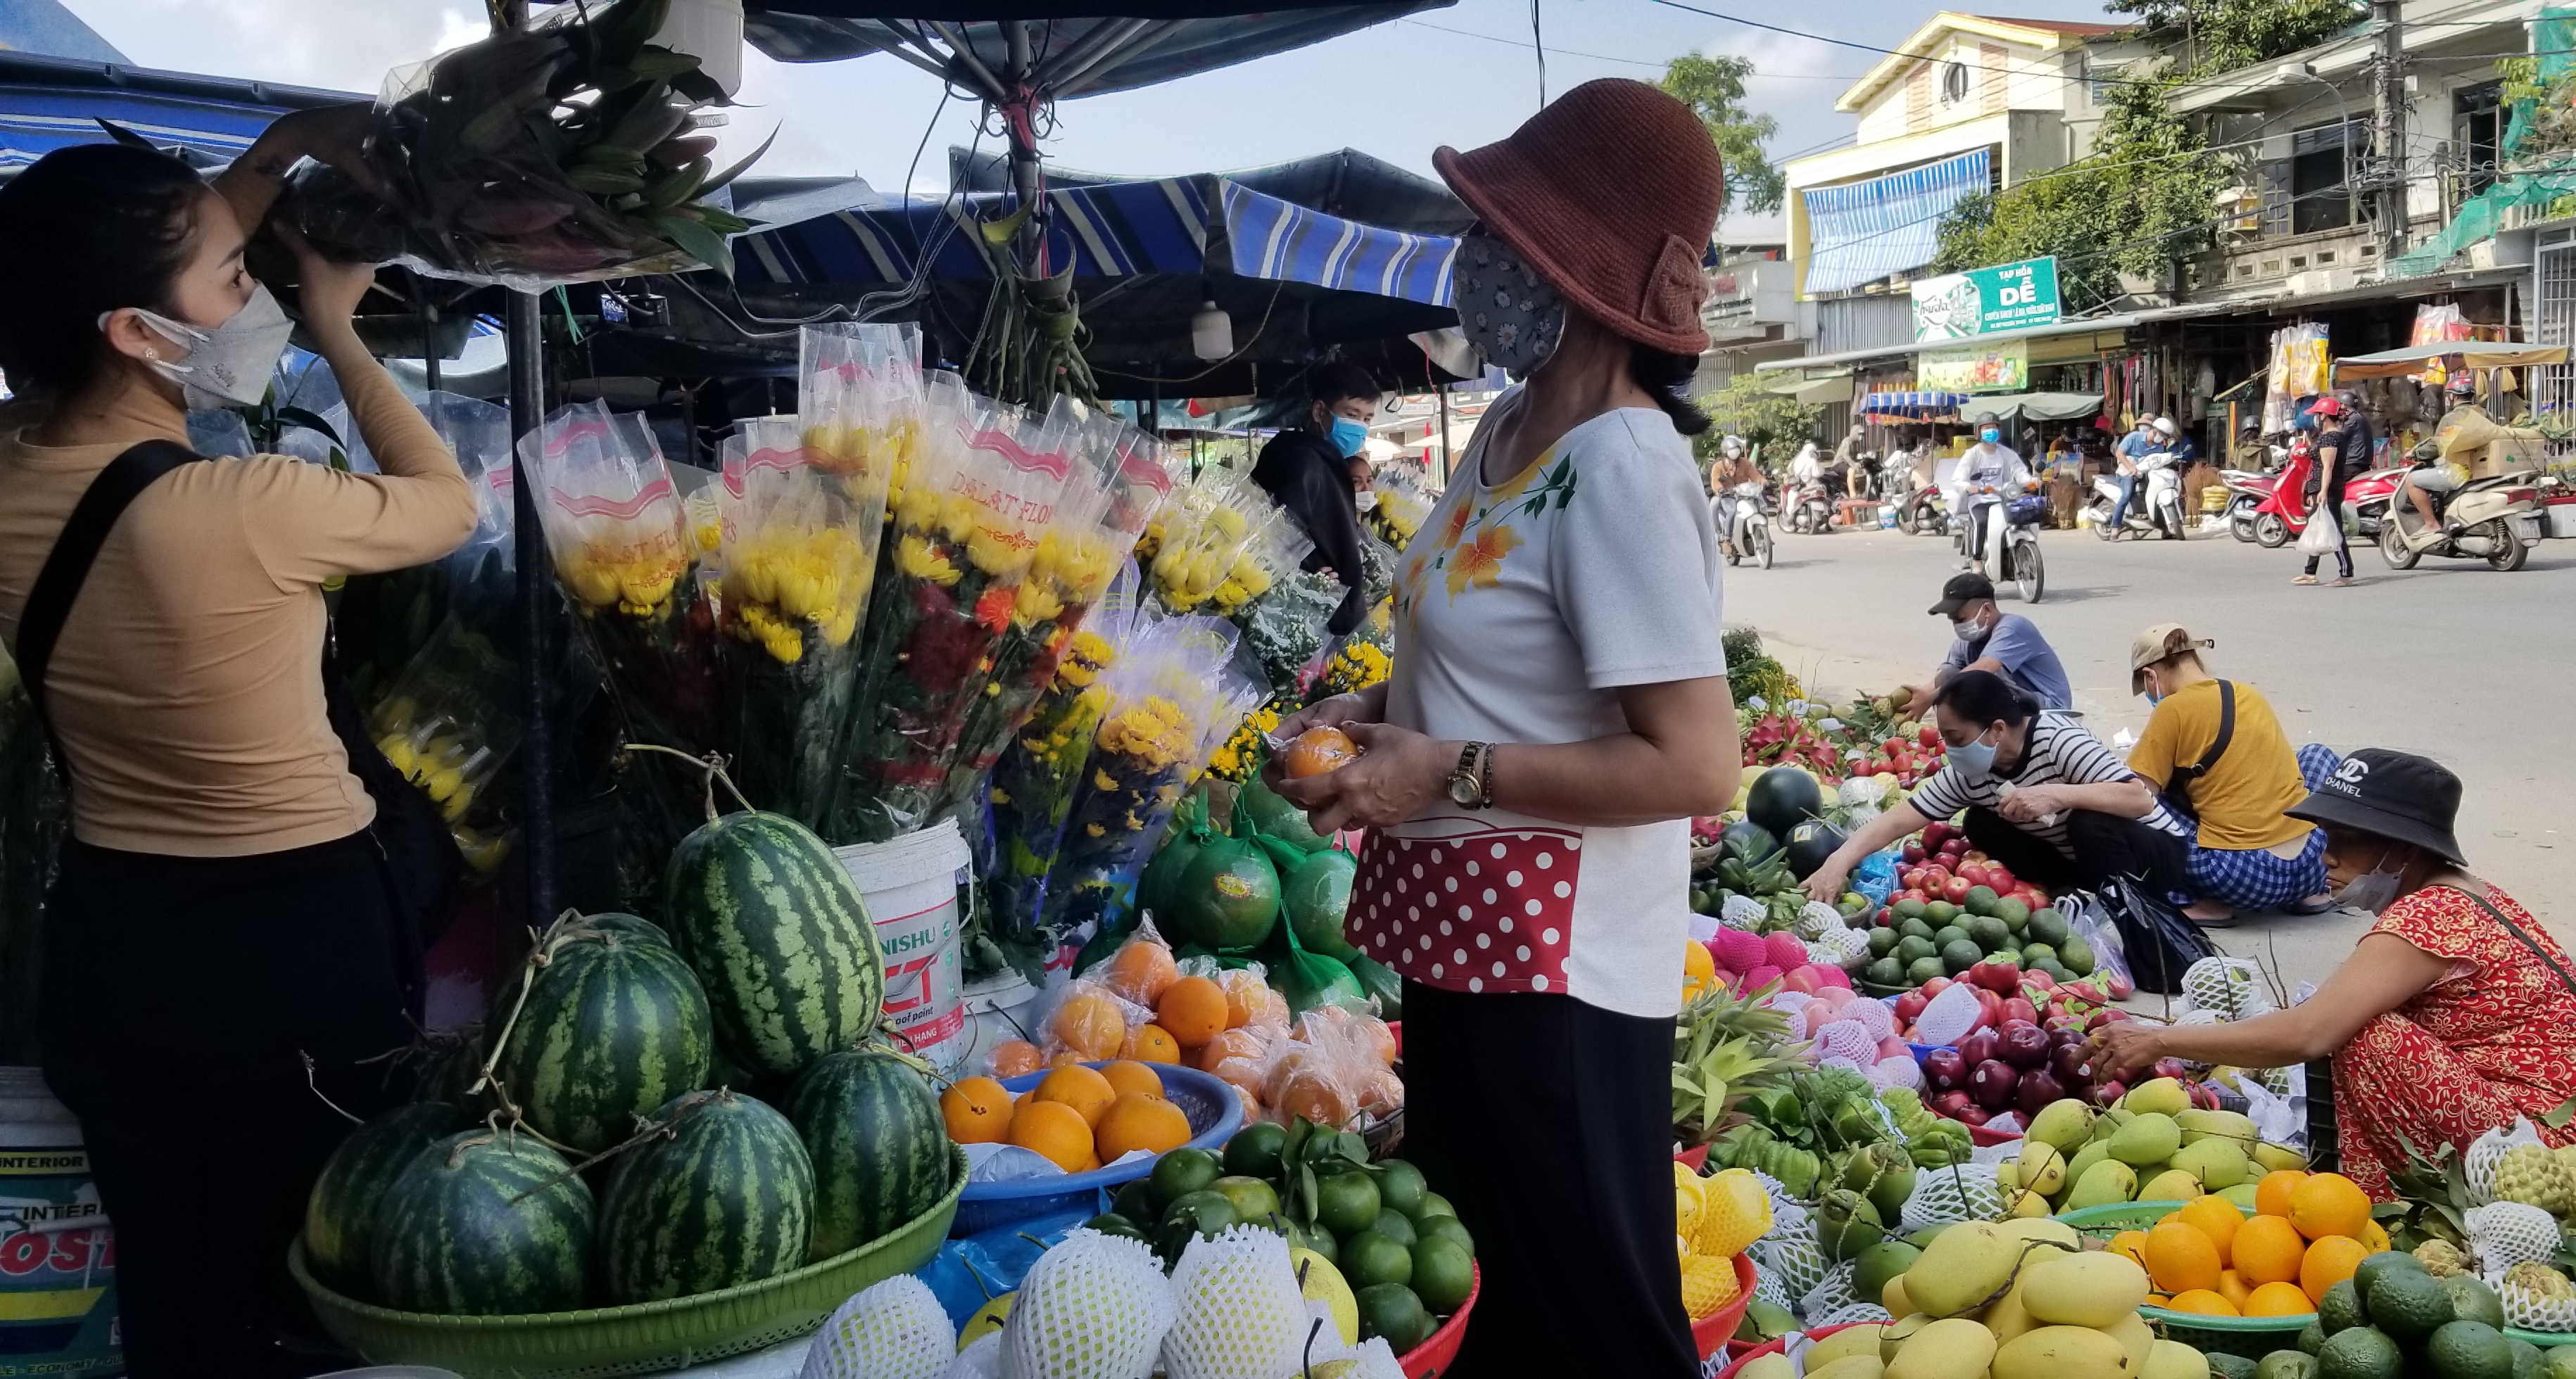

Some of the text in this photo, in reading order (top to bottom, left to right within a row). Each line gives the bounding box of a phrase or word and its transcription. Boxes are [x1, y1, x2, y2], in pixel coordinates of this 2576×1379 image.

[2325, 777, 2361, 798] CHANEL
[912, 1006, 934, 1024] paint
[915, 1027, 937, 1043] HANG
